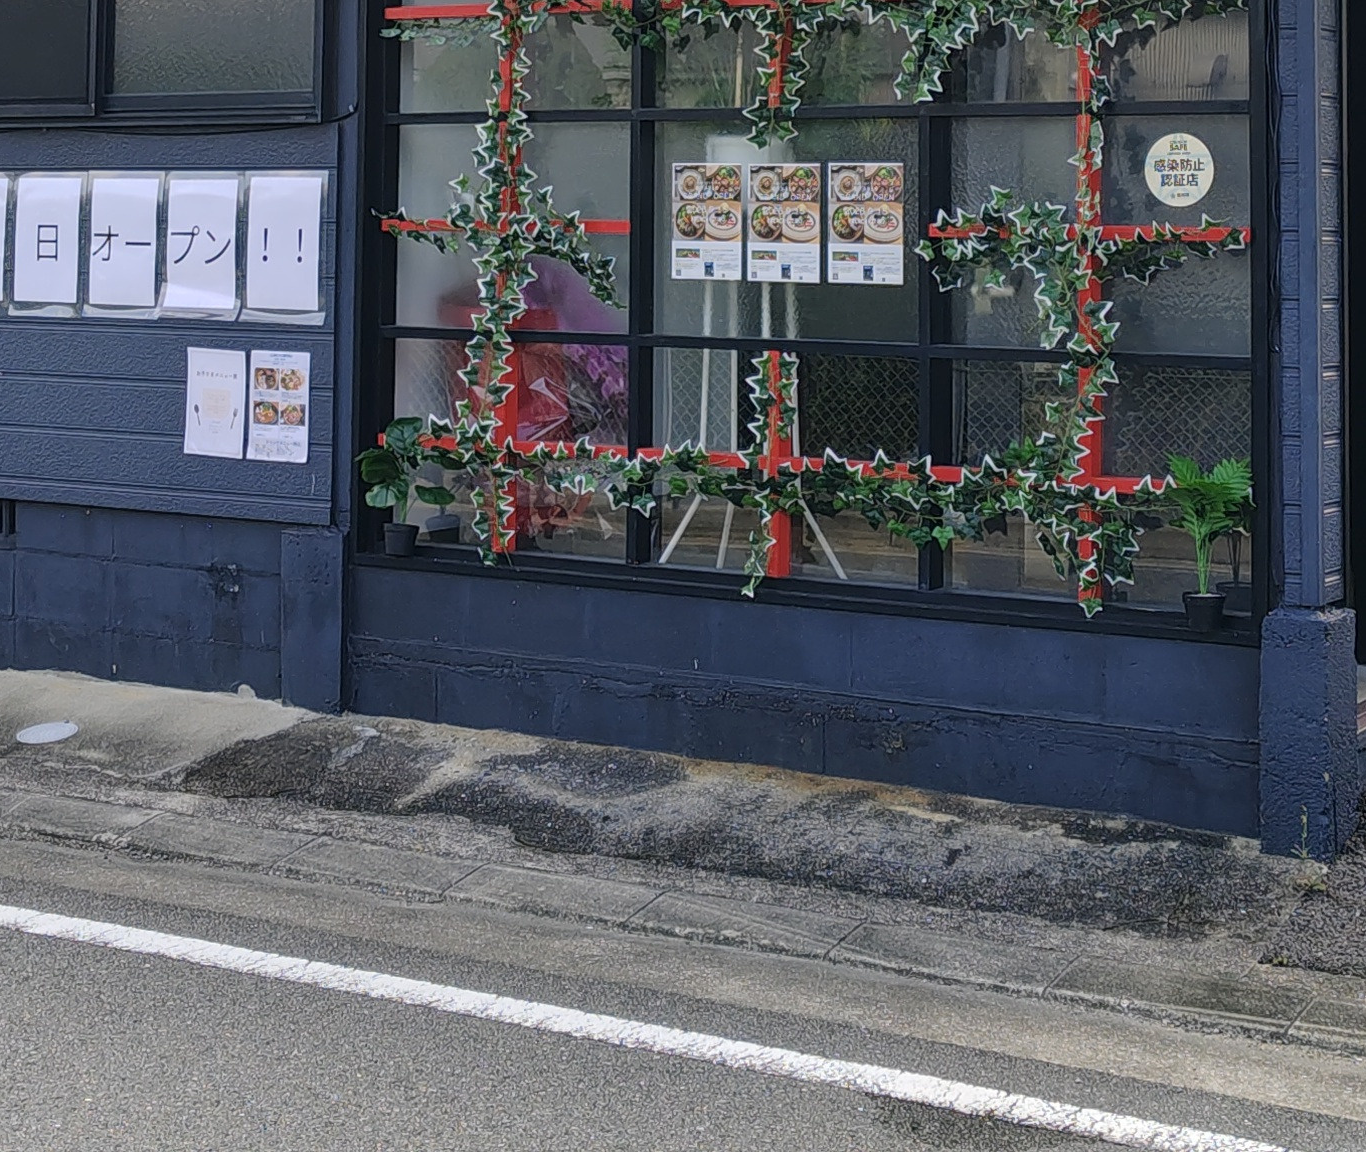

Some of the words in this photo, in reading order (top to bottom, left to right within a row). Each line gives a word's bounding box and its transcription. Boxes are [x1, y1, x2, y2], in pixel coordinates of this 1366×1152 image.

[1154, 158, 1205, 172] 感染防止
[1160, 173, 1199, 187] 認証店
